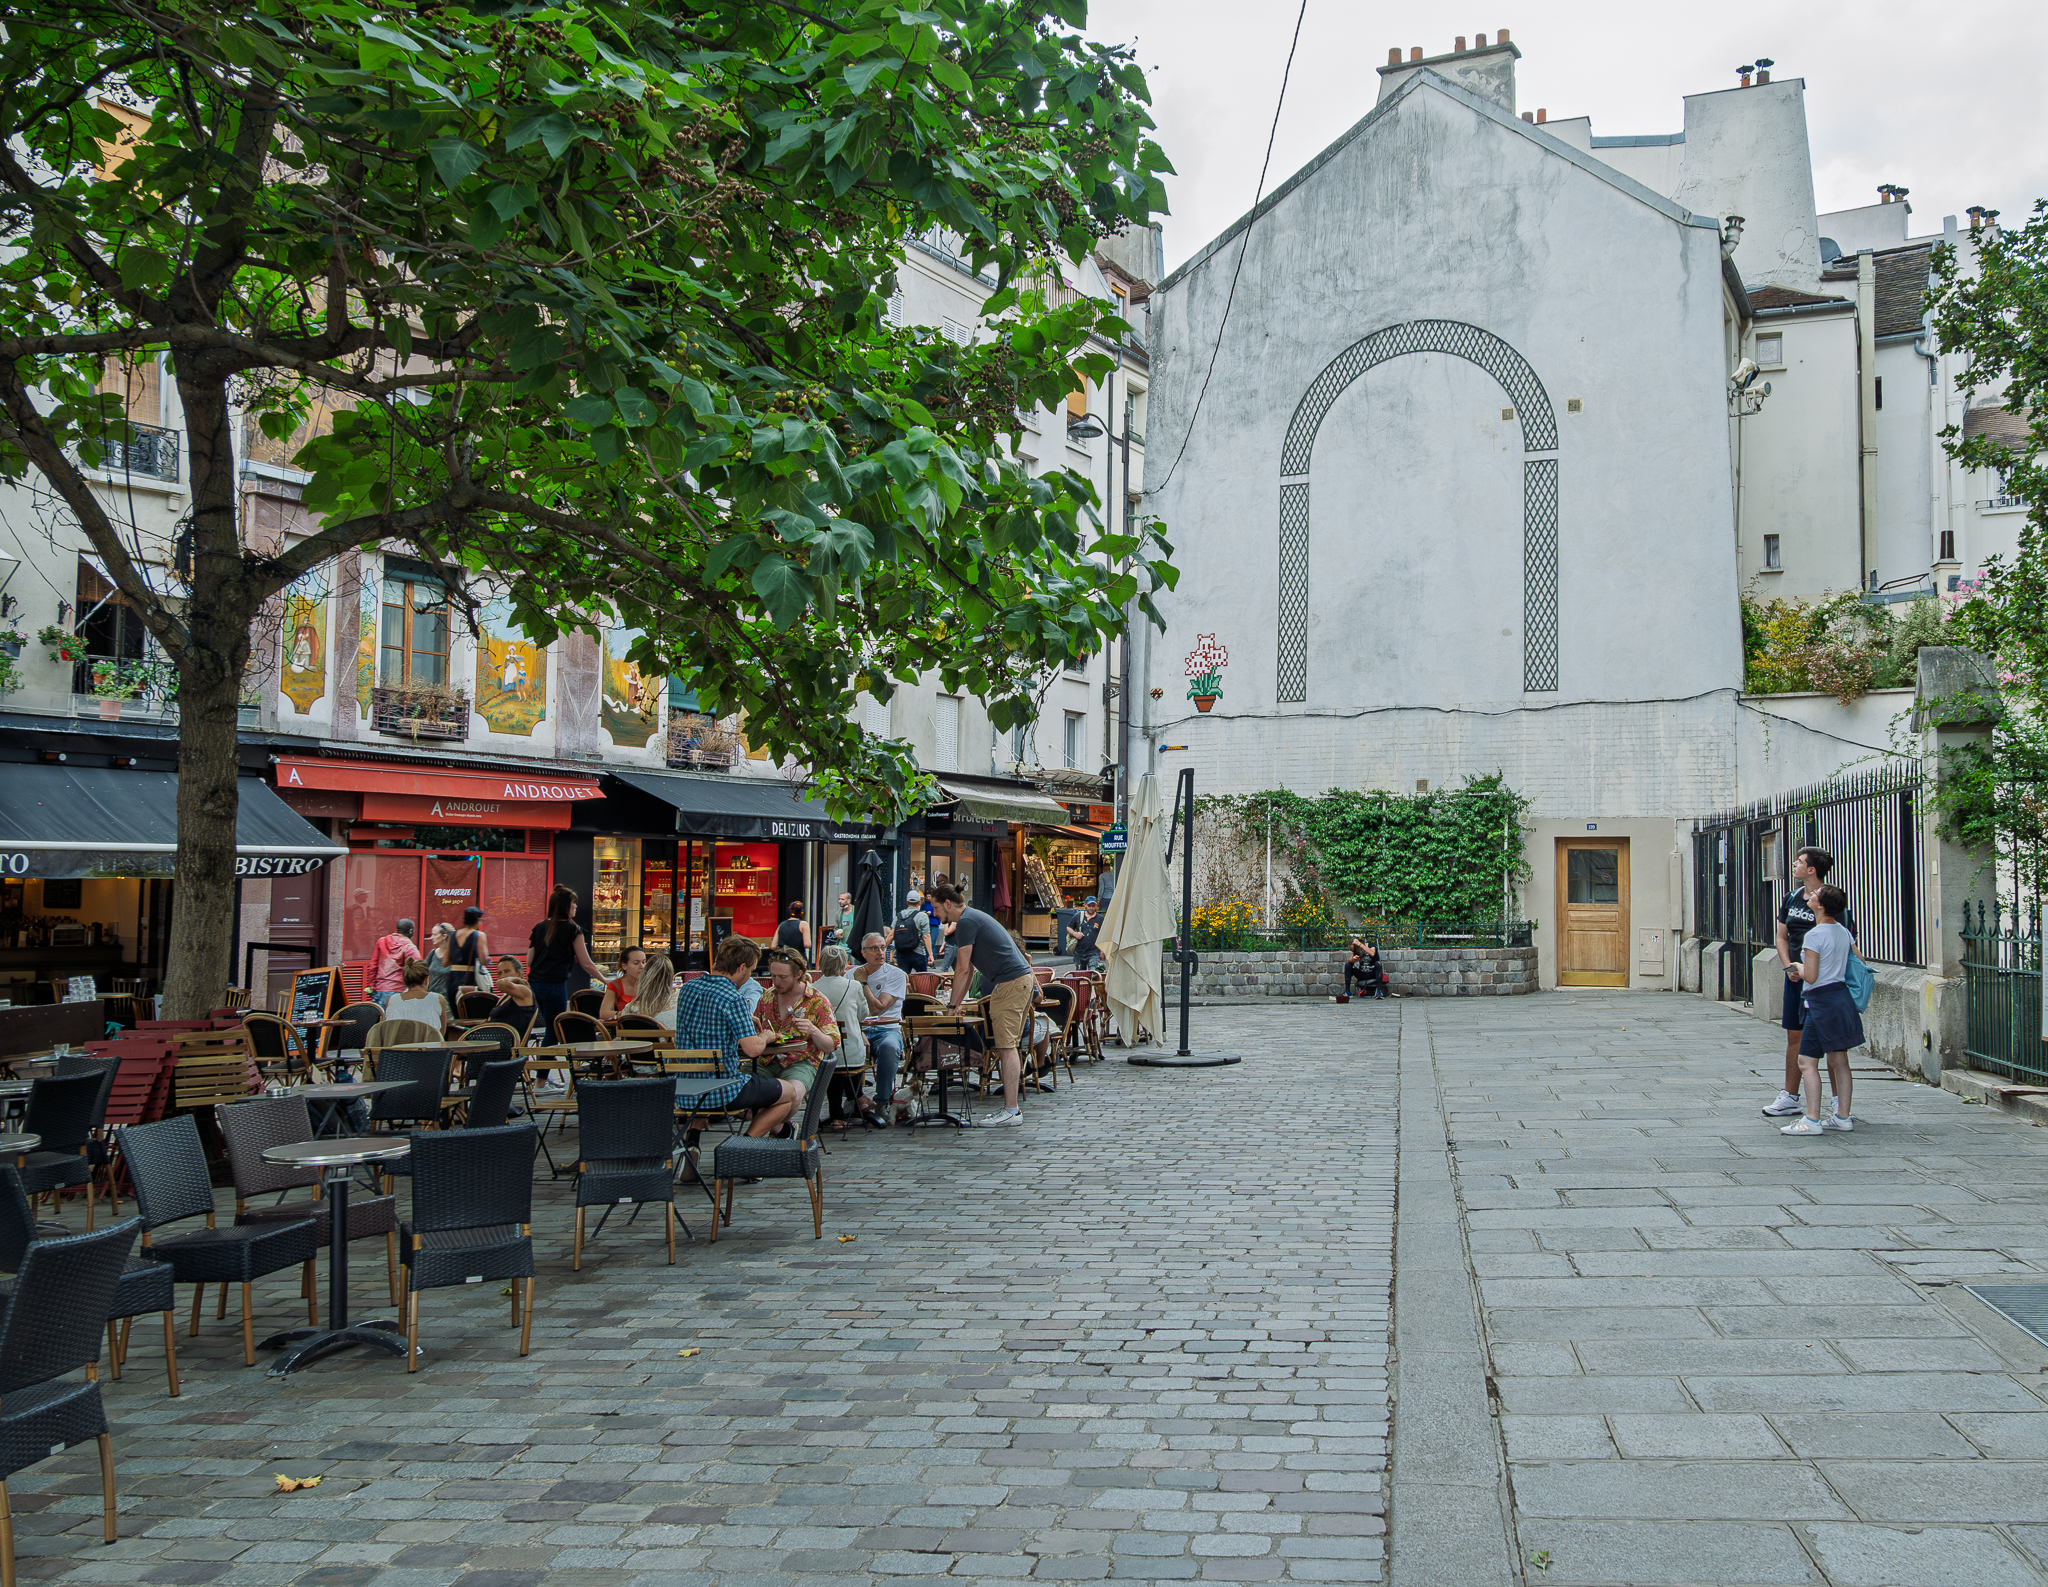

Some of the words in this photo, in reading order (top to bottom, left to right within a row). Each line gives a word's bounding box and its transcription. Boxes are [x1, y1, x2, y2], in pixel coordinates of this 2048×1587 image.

[288, 767, 303, 785] A
[503, 783, 594, 799] ANDROUET
[430, 800, 444, 818] A
[446, 802, 501, 812] ANDROUET
[772, 821, 811, 837] DELIZIUS
[235, 857, 323, 875] BISTRO
